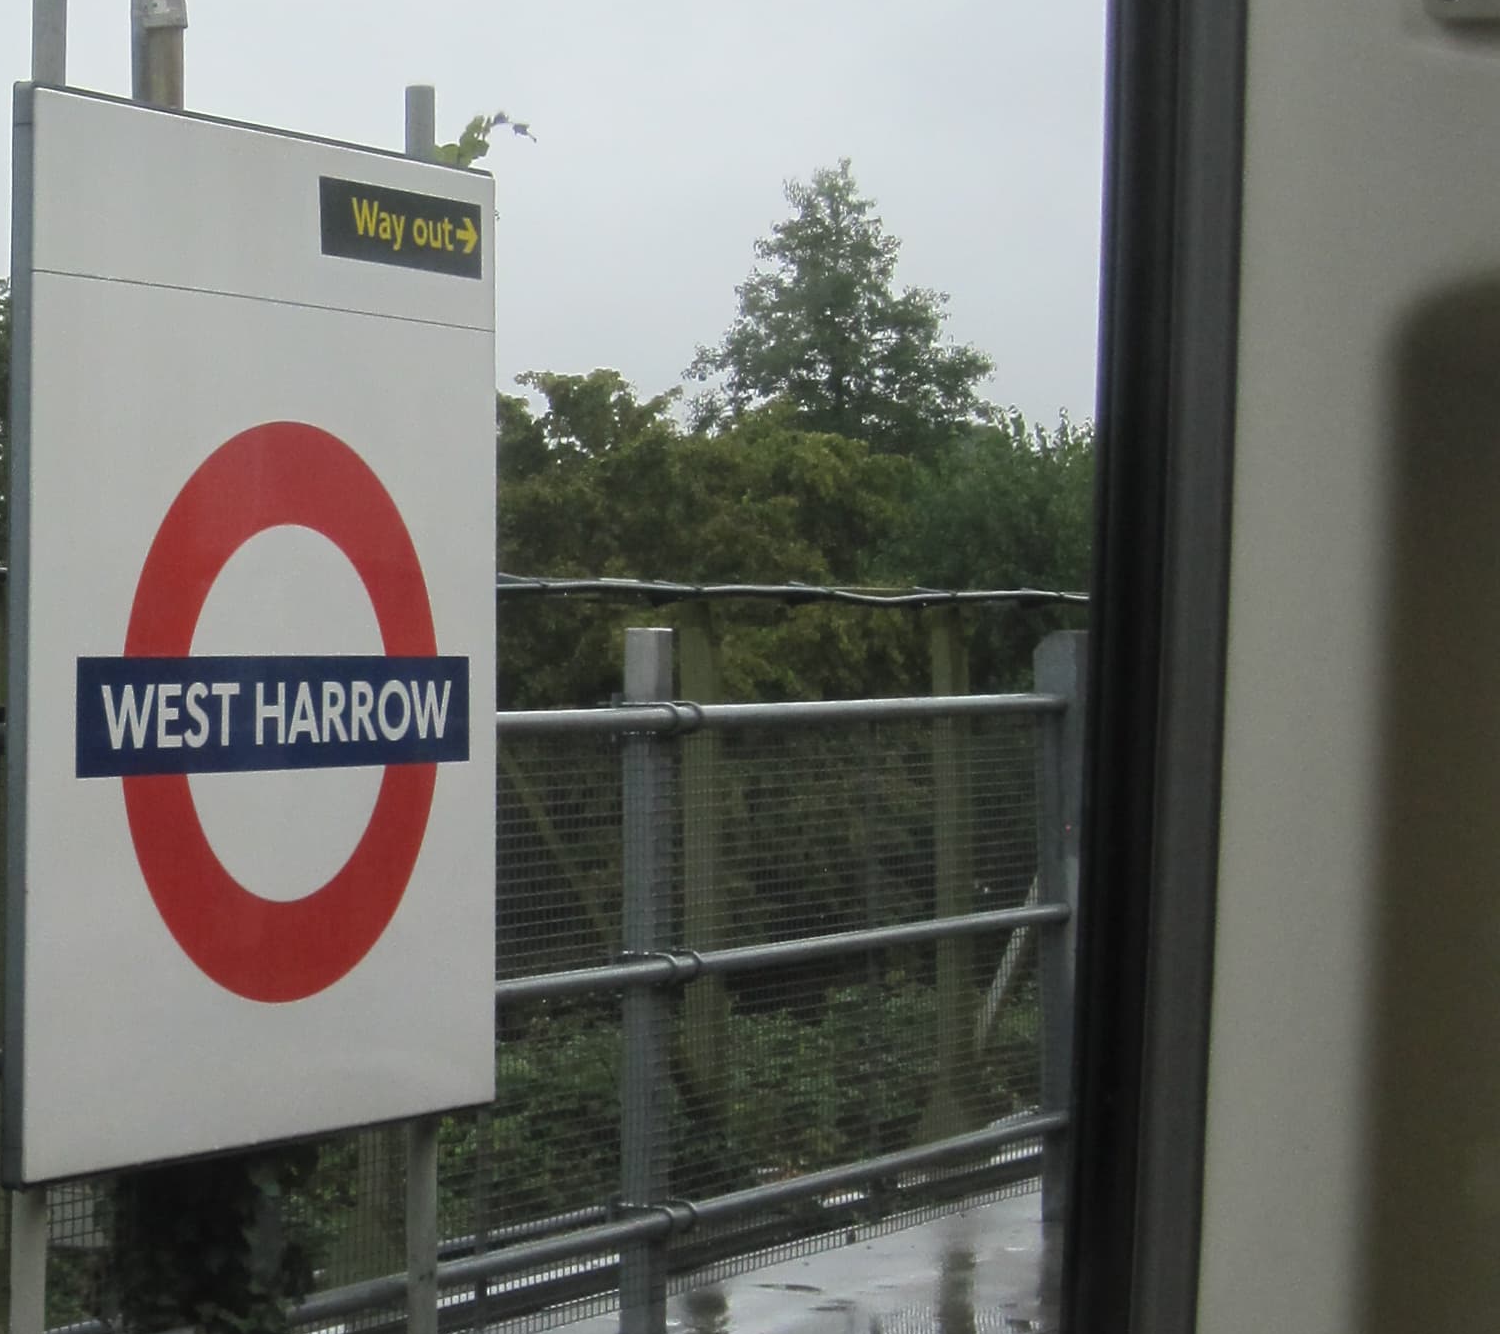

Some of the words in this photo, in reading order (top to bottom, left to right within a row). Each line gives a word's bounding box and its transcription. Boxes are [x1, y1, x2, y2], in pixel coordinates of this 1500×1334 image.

[352, 197, 405, 251] Way
[412, 218, 454, 252] out
[101, 681, 241, 750] WEST
[255, 679, 452, 745] HARROW
